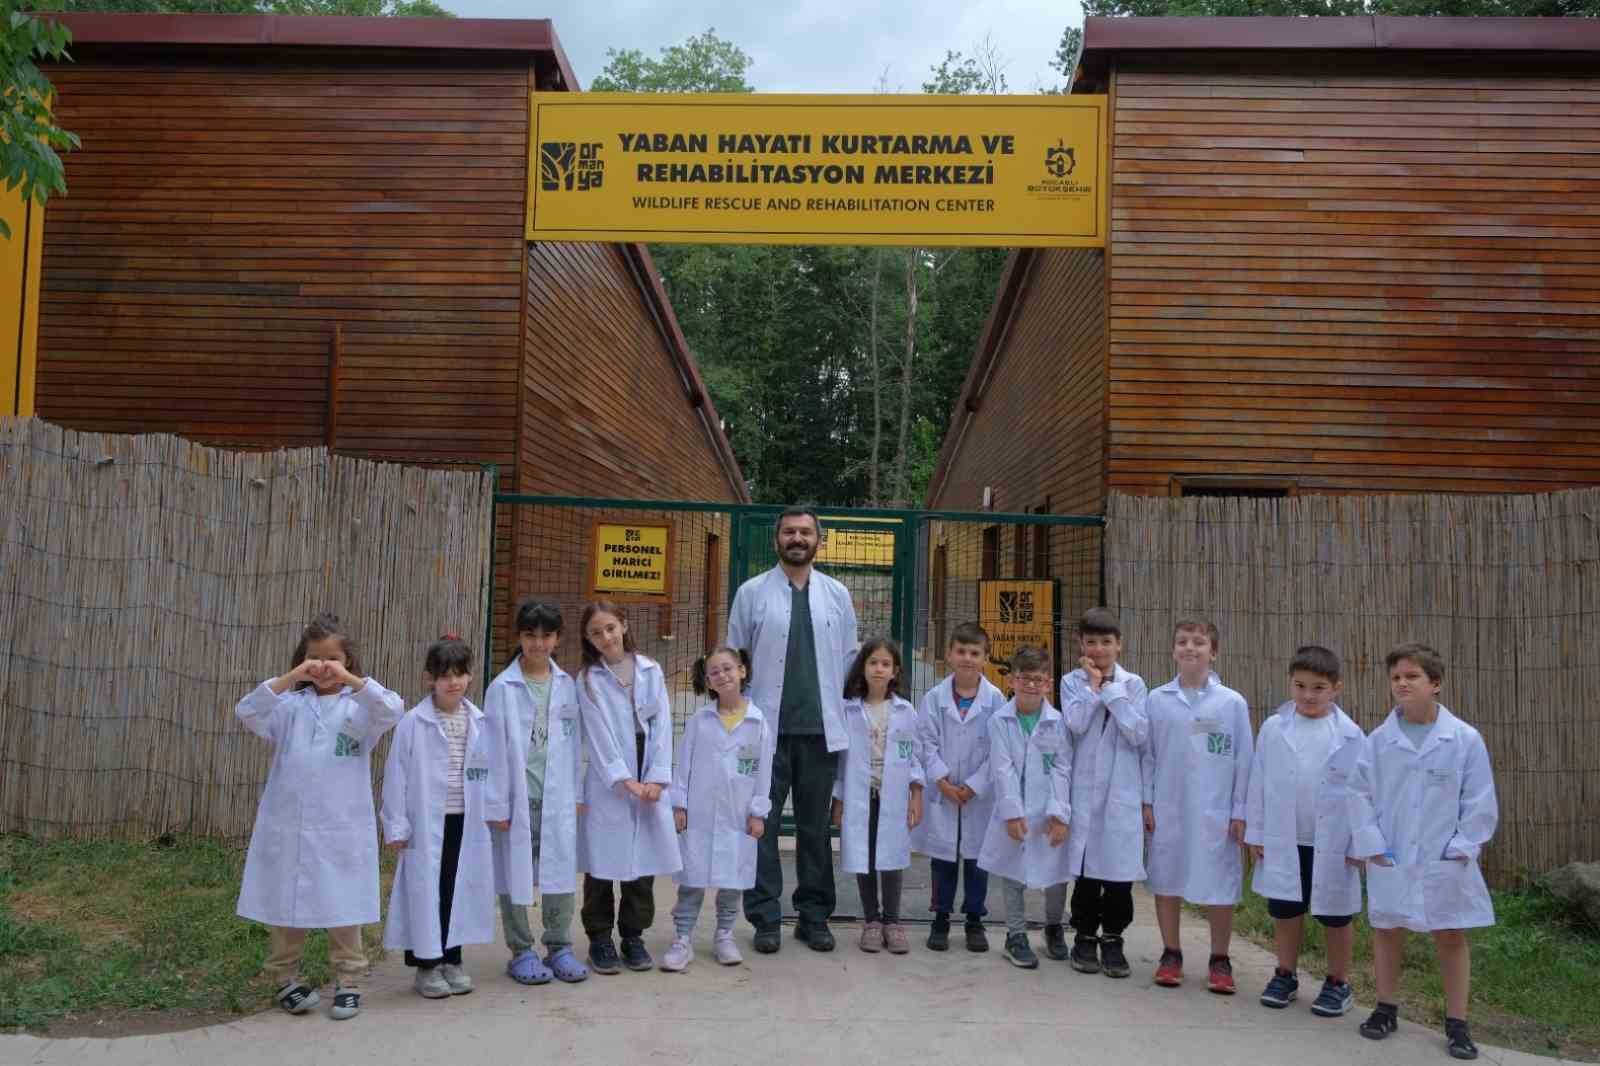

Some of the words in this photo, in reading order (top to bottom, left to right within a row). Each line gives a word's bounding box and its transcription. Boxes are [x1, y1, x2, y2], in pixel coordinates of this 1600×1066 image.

[618, 133, 708, 152] YABAN
[718, 134, 811, 153] HAYATI
[822, 134, 974, 154] KURTARMA
[981, 135, 1015, 154] VE
[577, 171, 603, 191] ya
[637, 158, 865, 184] REHABİLİTASYON
[874, 159, 994, 185] MERKEZİ
[632, 196, 699, 209] WILDLIFE
[704, 197, 761, 210] RESCUE
[767, 198, 800, 210] AND
[806, 198, 930, 212] REHABILITATION
[935, 198, 995, 212] CENTER
[604, 543, 662, 555] PERSONEL
